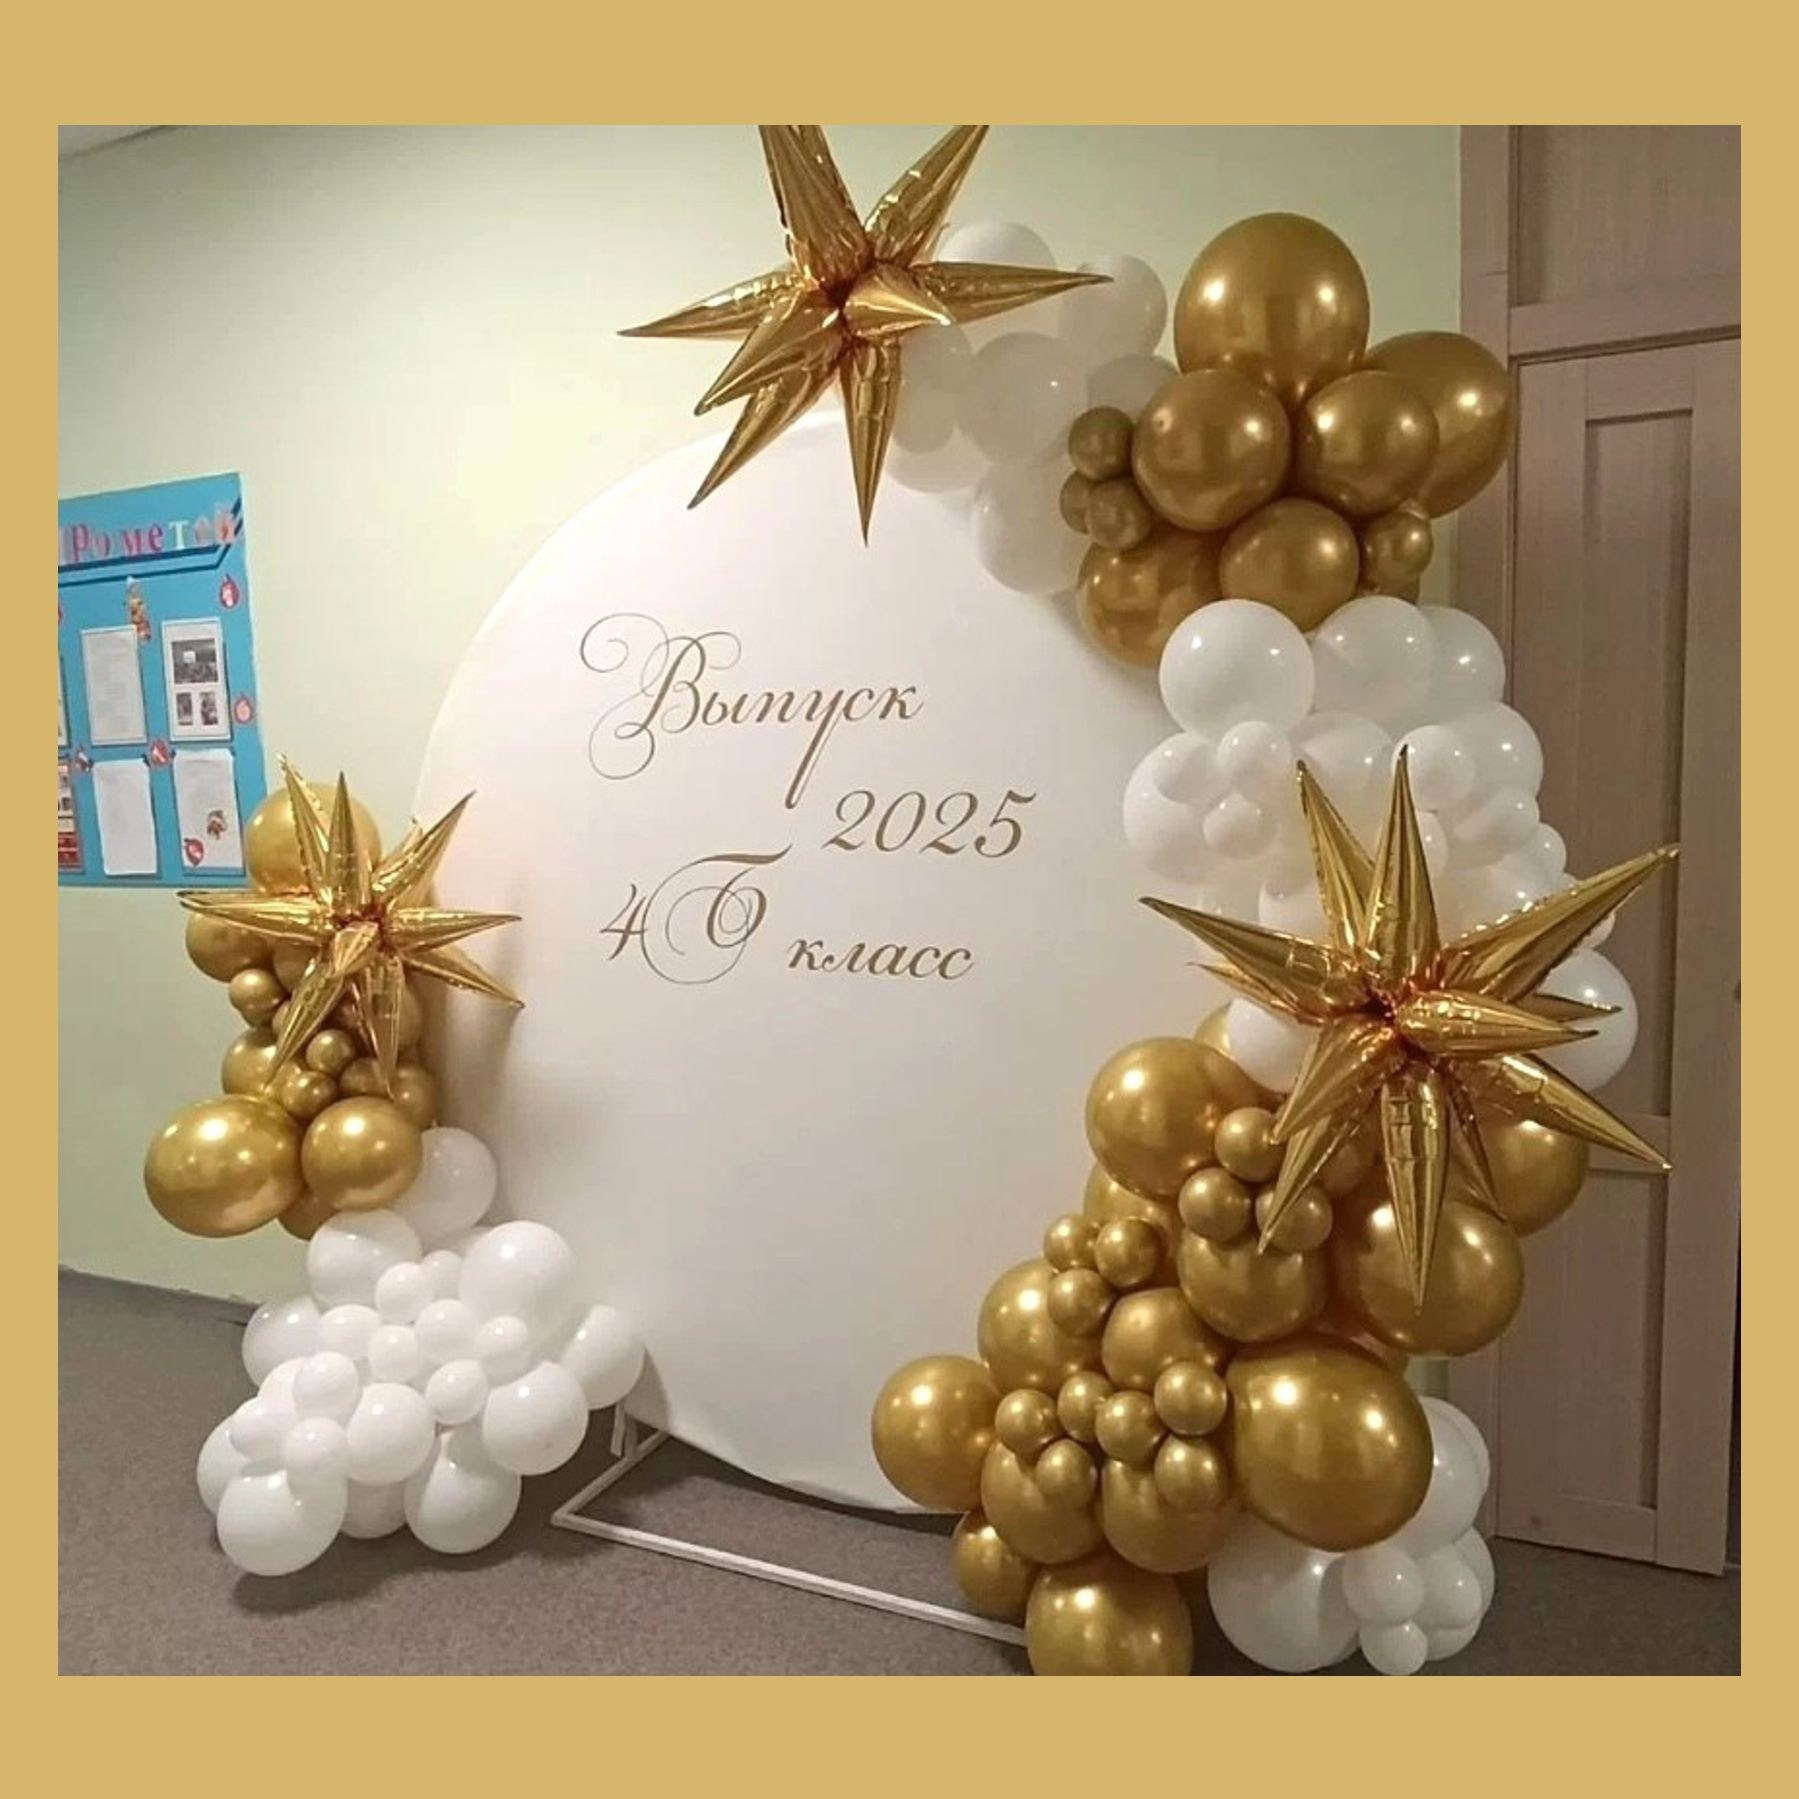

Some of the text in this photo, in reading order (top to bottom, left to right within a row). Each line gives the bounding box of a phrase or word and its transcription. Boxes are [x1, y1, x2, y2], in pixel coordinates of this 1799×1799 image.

[580, 612, 925, 810] Выпуск
[821, 789, 1037, 858] 2025
[788, 938, 975, 981] класс
